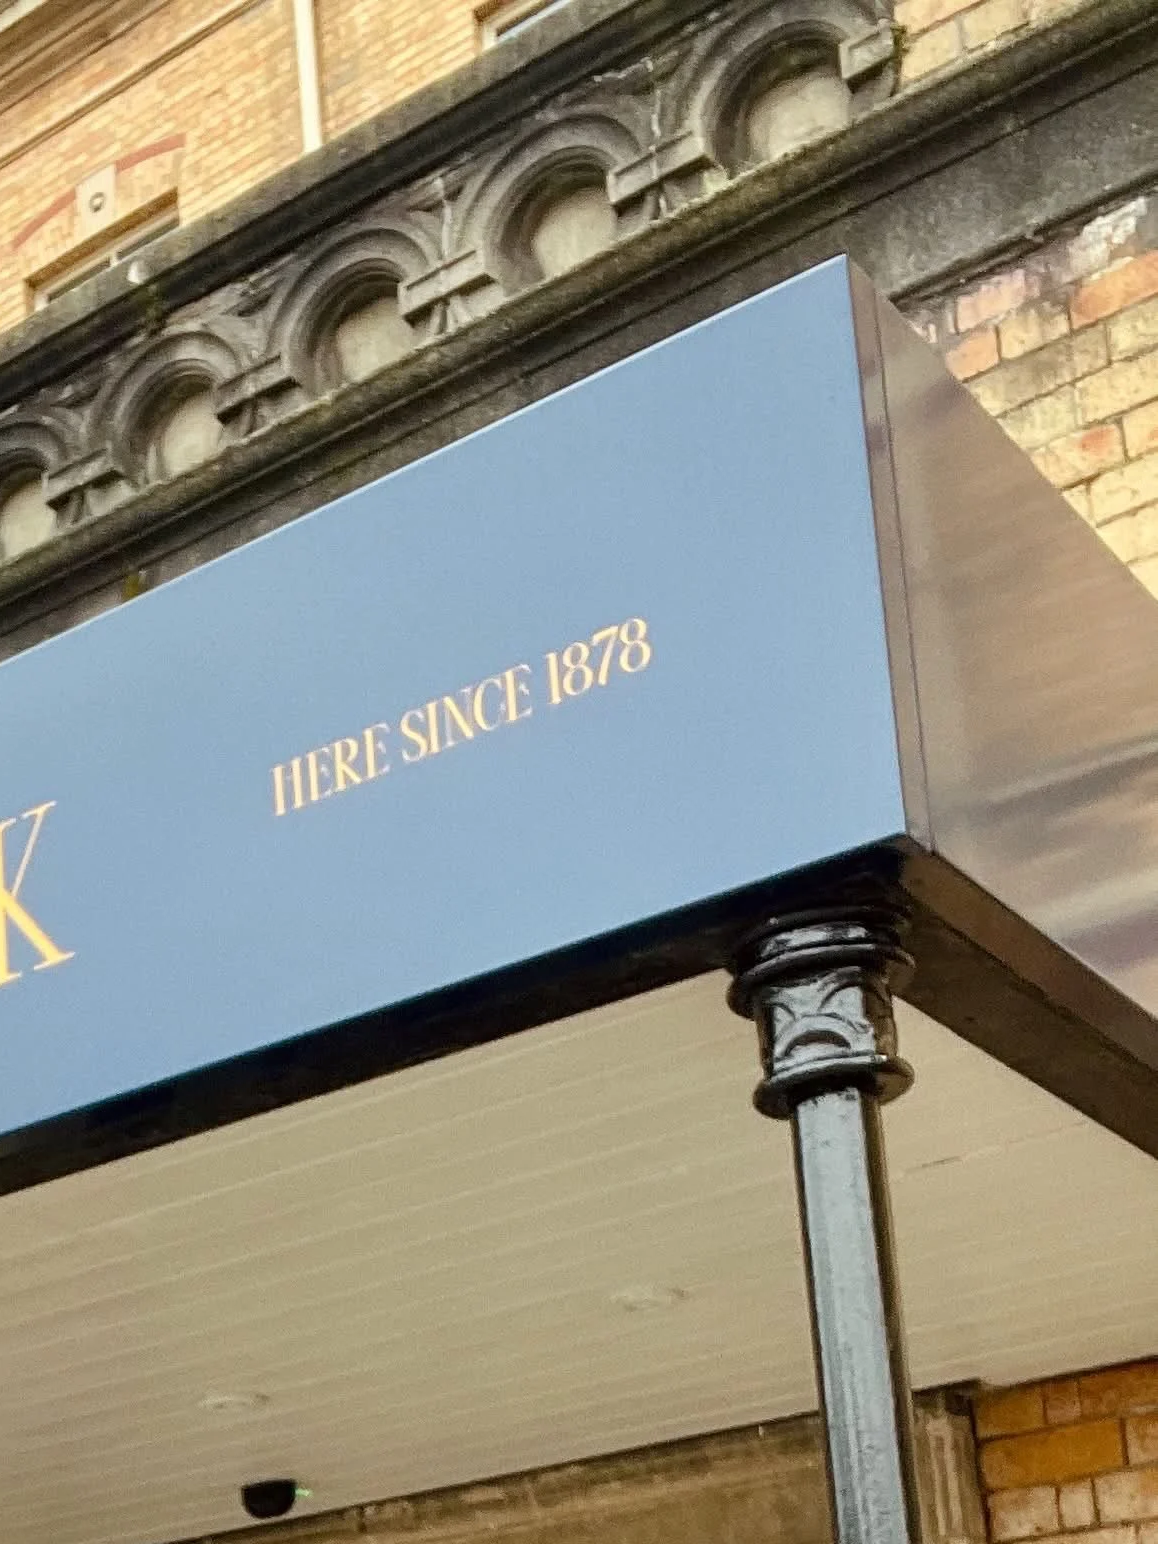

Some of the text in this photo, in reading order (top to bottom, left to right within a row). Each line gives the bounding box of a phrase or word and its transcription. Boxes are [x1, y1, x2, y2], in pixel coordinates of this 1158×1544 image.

[270, 617, 652, 816] HERE SINCE 1878
